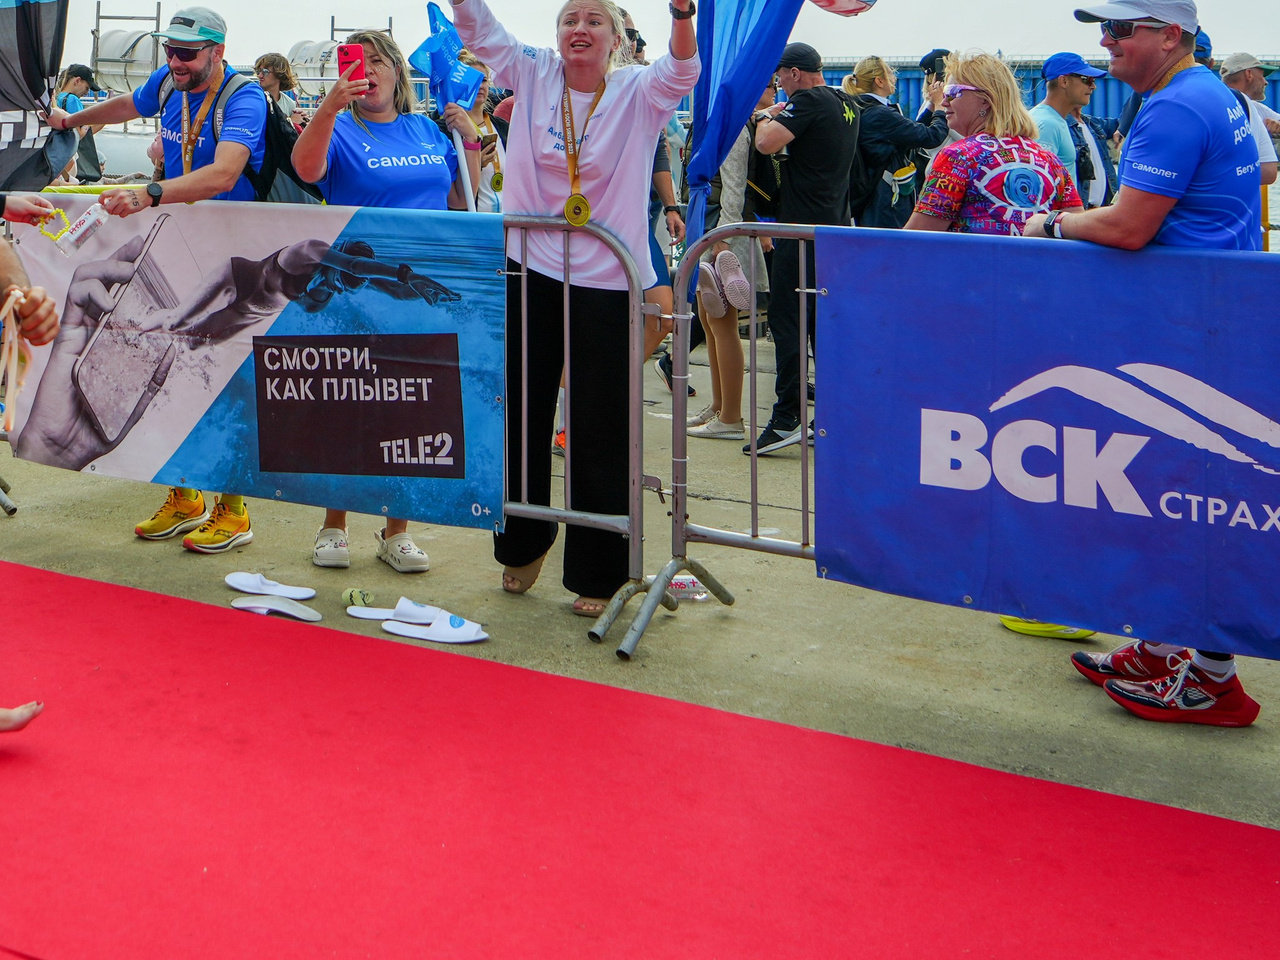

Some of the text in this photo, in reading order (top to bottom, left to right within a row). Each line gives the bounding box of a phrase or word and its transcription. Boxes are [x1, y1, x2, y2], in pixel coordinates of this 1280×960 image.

[1132, 161, 1179, 179] самолет
[263, 347, 378, 374] СМОТРИ,
[265, 377, 433, 401] КАК ПЛЫВЕТ
[379, 432, 454, 466] TELE2
[920, 407, 1153, 518] ВСК
[471, 503, 492, 517] 0+
